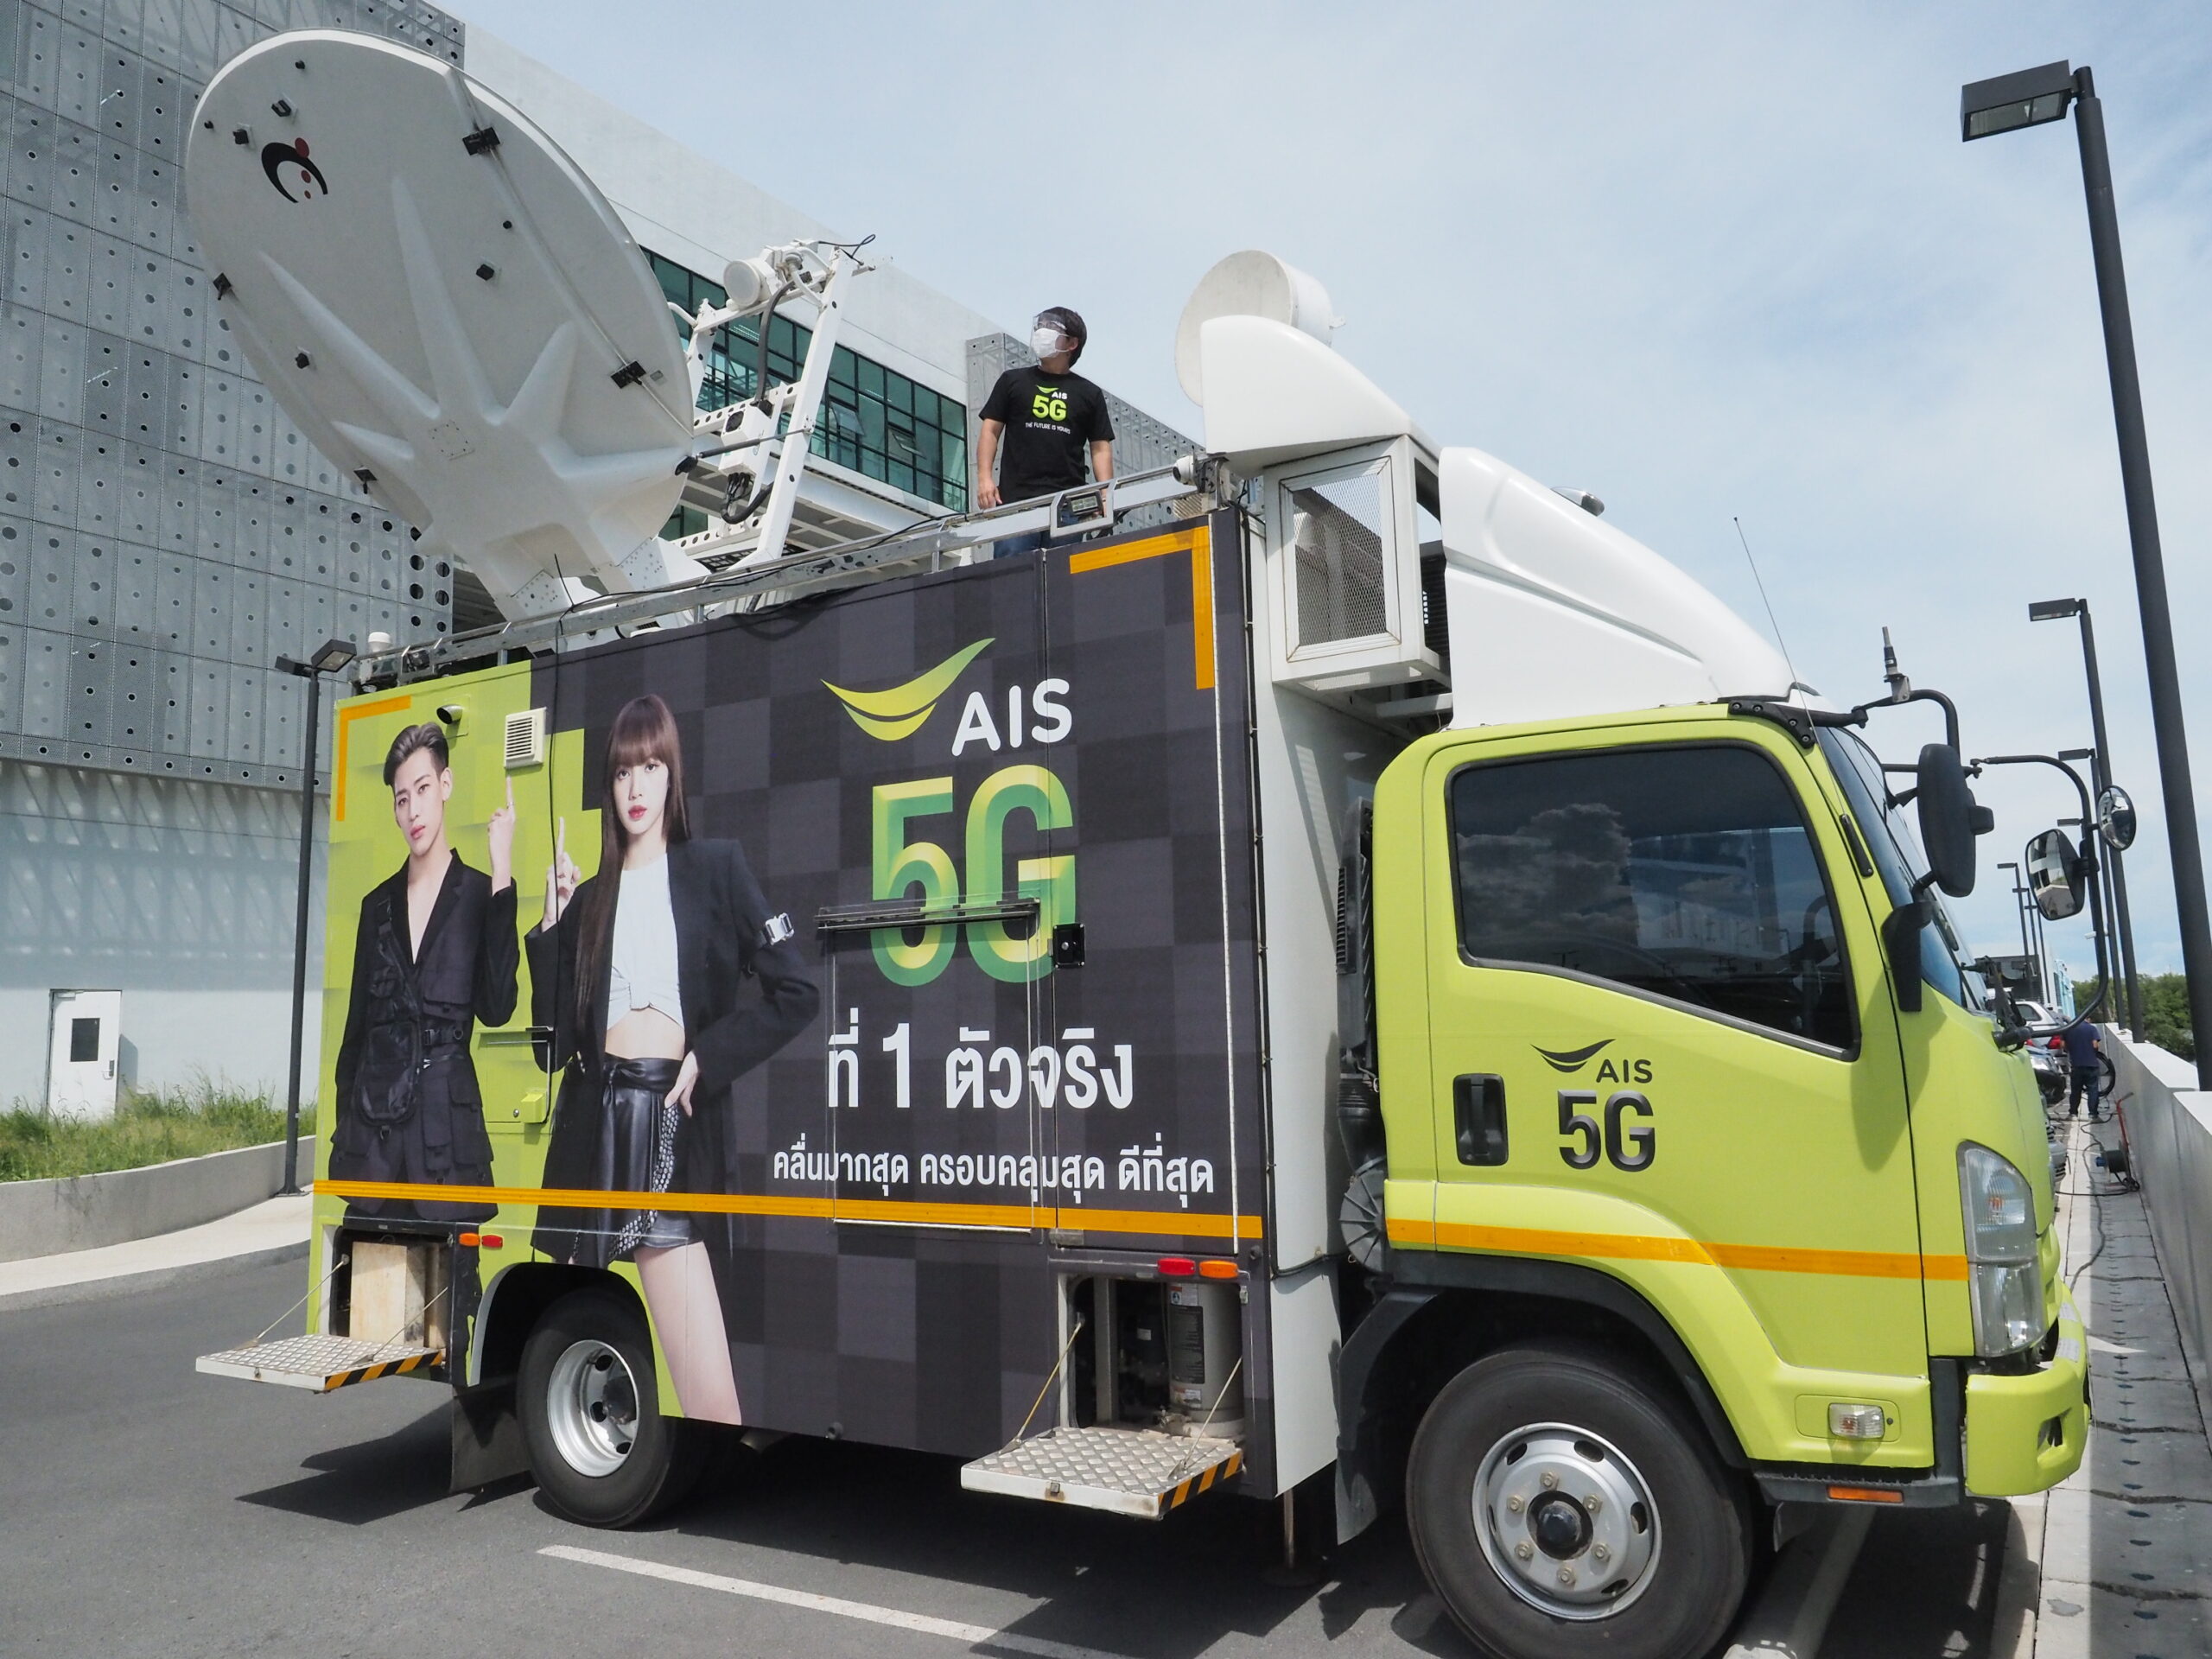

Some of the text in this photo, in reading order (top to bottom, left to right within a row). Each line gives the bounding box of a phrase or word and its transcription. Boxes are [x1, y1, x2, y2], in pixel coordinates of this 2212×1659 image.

[1032, 394, 1067, 422] 5G
[1033, 422, 1052, 430] FUTURE
[1057, 426, 1071, 435] YOURS
[1052, 391, 1068, 400] AIS
[951, 678, 1072, 756] AIS
[870, 765, 1077, 987] 5G
[828, 1007, 1134, 1109] ที่ 1 ตัวจริง
[1596, 1058, 1653, 1084] AIS
[1557, 1089, 1656, 1173] 5G
[773, 1132, 1214, 1208] คลื่นมากสุด ครอบคลุมสุด ดีที่สุด
